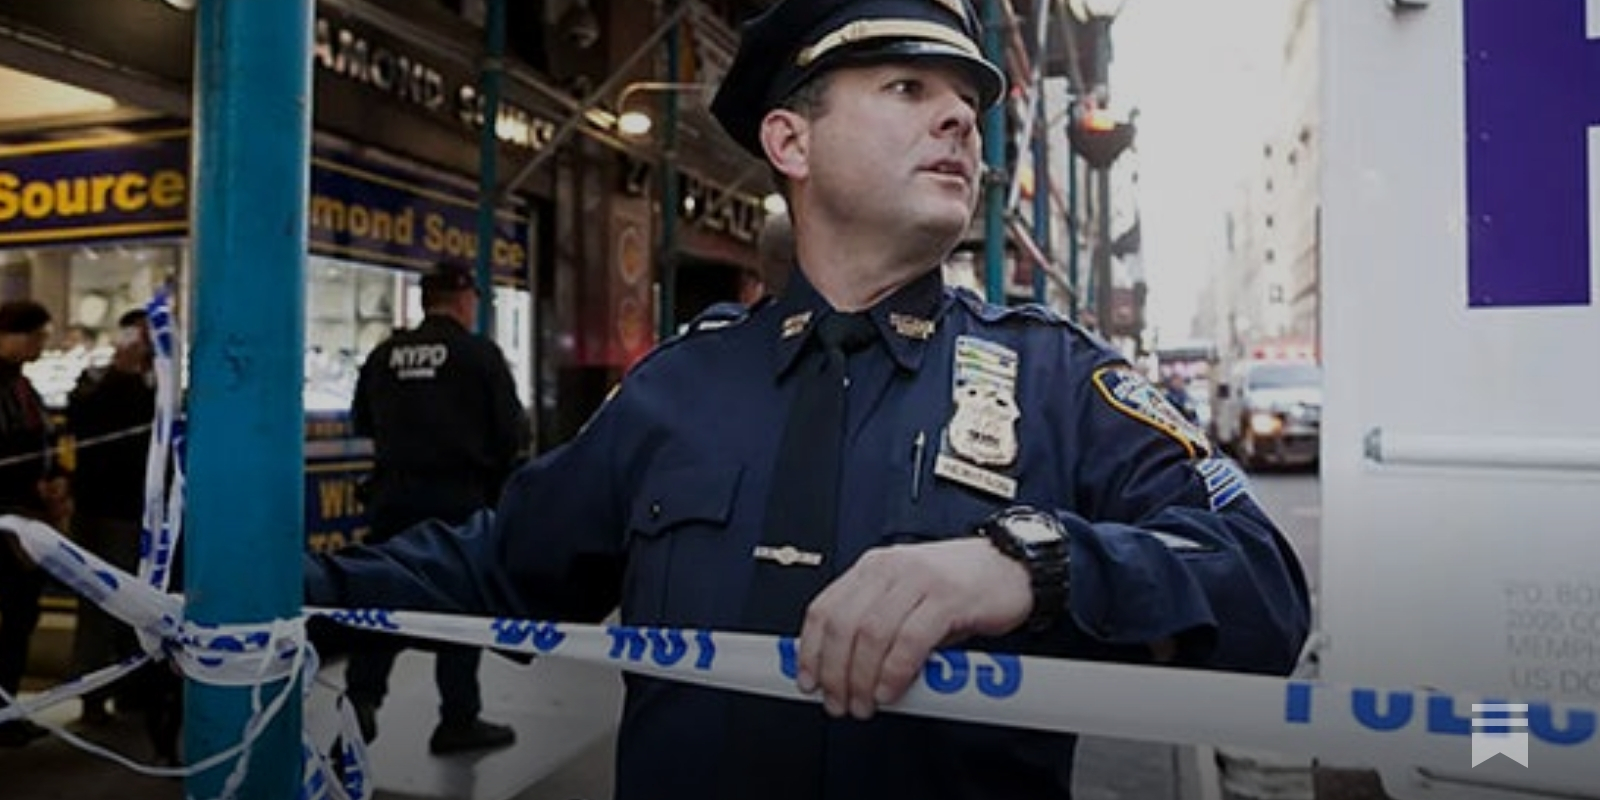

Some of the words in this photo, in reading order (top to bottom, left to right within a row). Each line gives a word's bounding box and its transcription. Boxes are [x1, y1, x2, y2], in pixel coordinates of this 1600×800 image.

[314, 18, 444, 111] AMOND
[0, 170, 185, 220] Source
[312, 196, 414, 245] mond
[424, 213, 525, 268] Souce
[389, 344, 448, 368] NYPD
